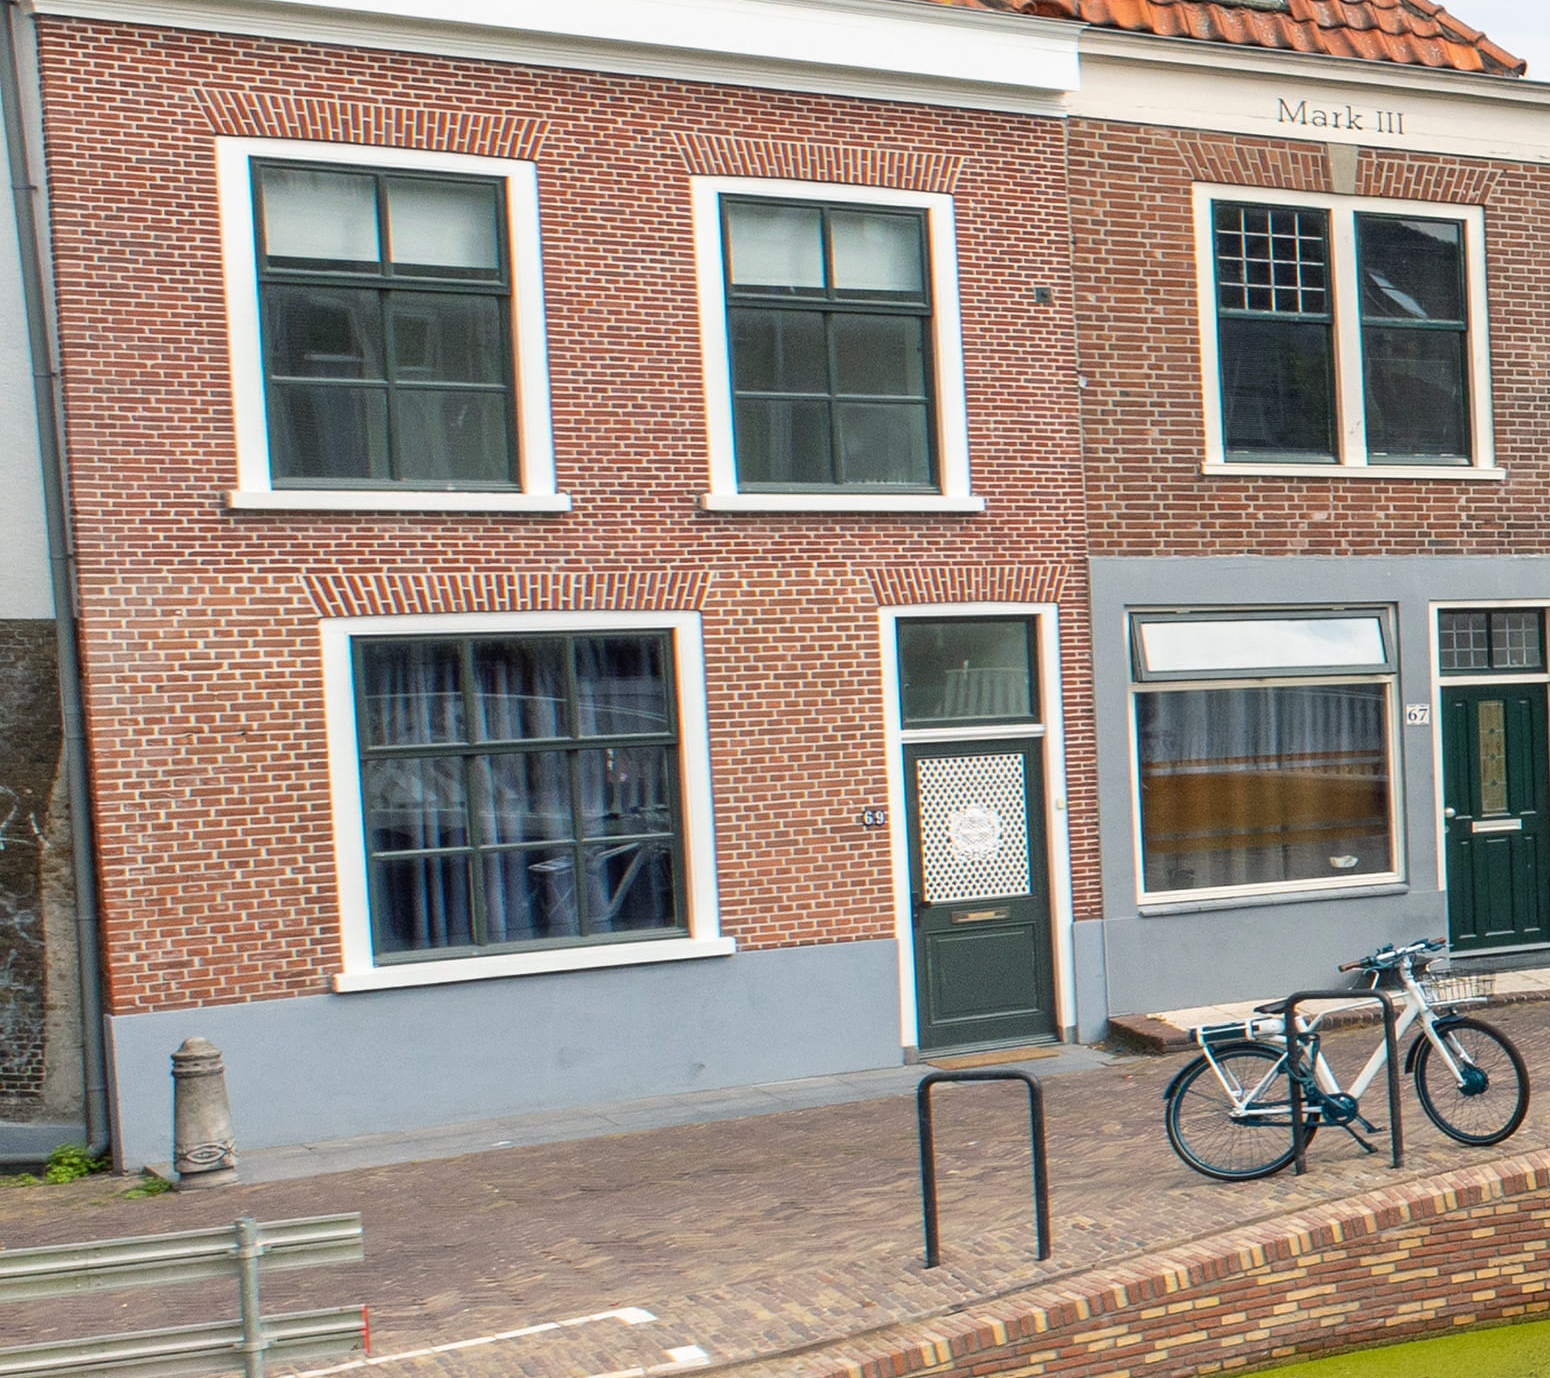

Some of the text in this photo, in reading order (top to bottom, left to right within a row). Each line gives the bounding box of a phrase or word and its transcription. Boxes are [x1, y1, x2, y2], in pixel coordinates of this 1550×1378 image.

[1276, 97, 1405, 135] Mark III
[1408, 708, 1428, 722] 67
[863, 810, 885, 826] 69
